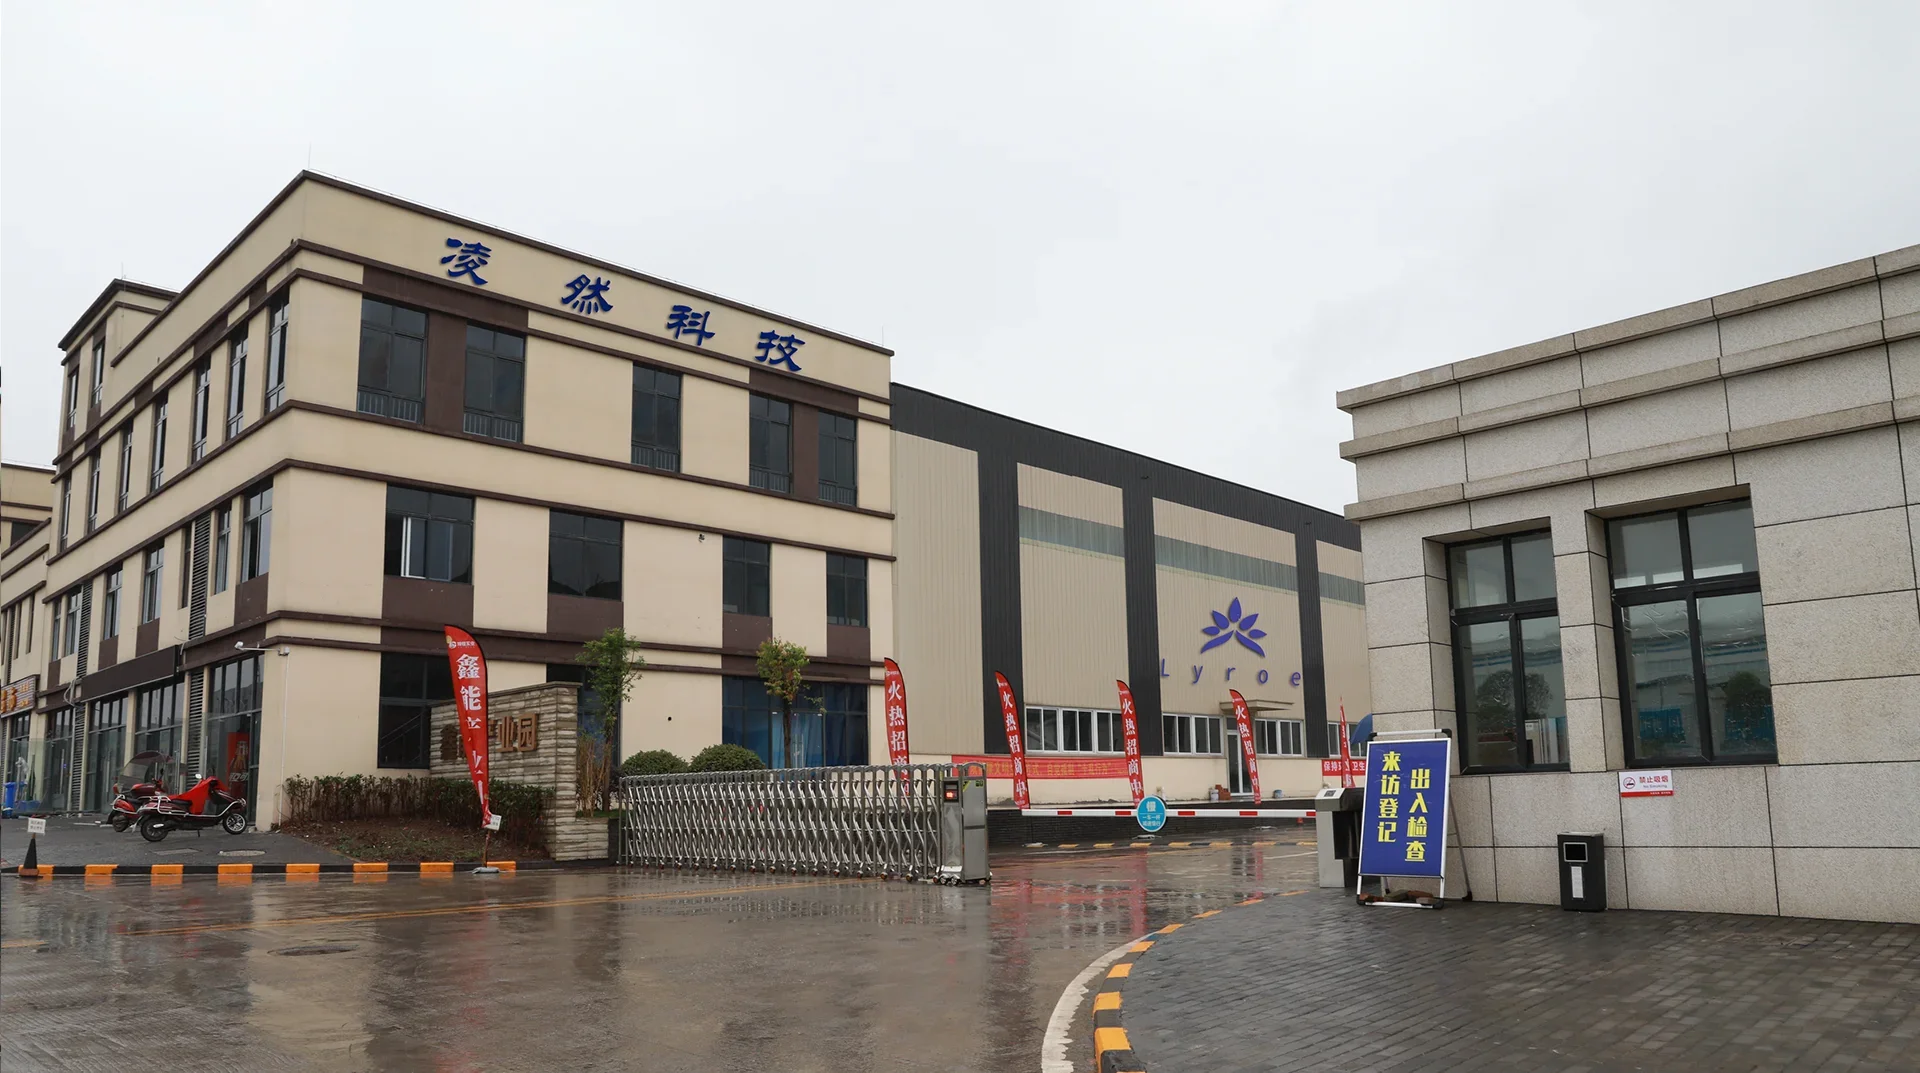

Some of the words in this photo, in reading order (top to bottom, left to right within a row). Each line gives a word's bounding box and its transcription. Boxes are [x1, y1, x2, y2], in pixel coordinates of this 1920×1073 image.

[440, 237, 806, 372] 凌然科技
[1160, 658, 1302, 686] Lyroe
[888, 680, 908, 794] 火热招商
[1003, 690, 1027, 797] 火热招商中
[1122, 698, 1143, 795] 火热招商中
[1324, 761, 1365, 772] 保持卫生
[1639, 775, 1669, 784] 禁止吸烟
[1377, 751, 1401, 842] 来访登记
[1405, 768, 1431, 862] 出入检查
